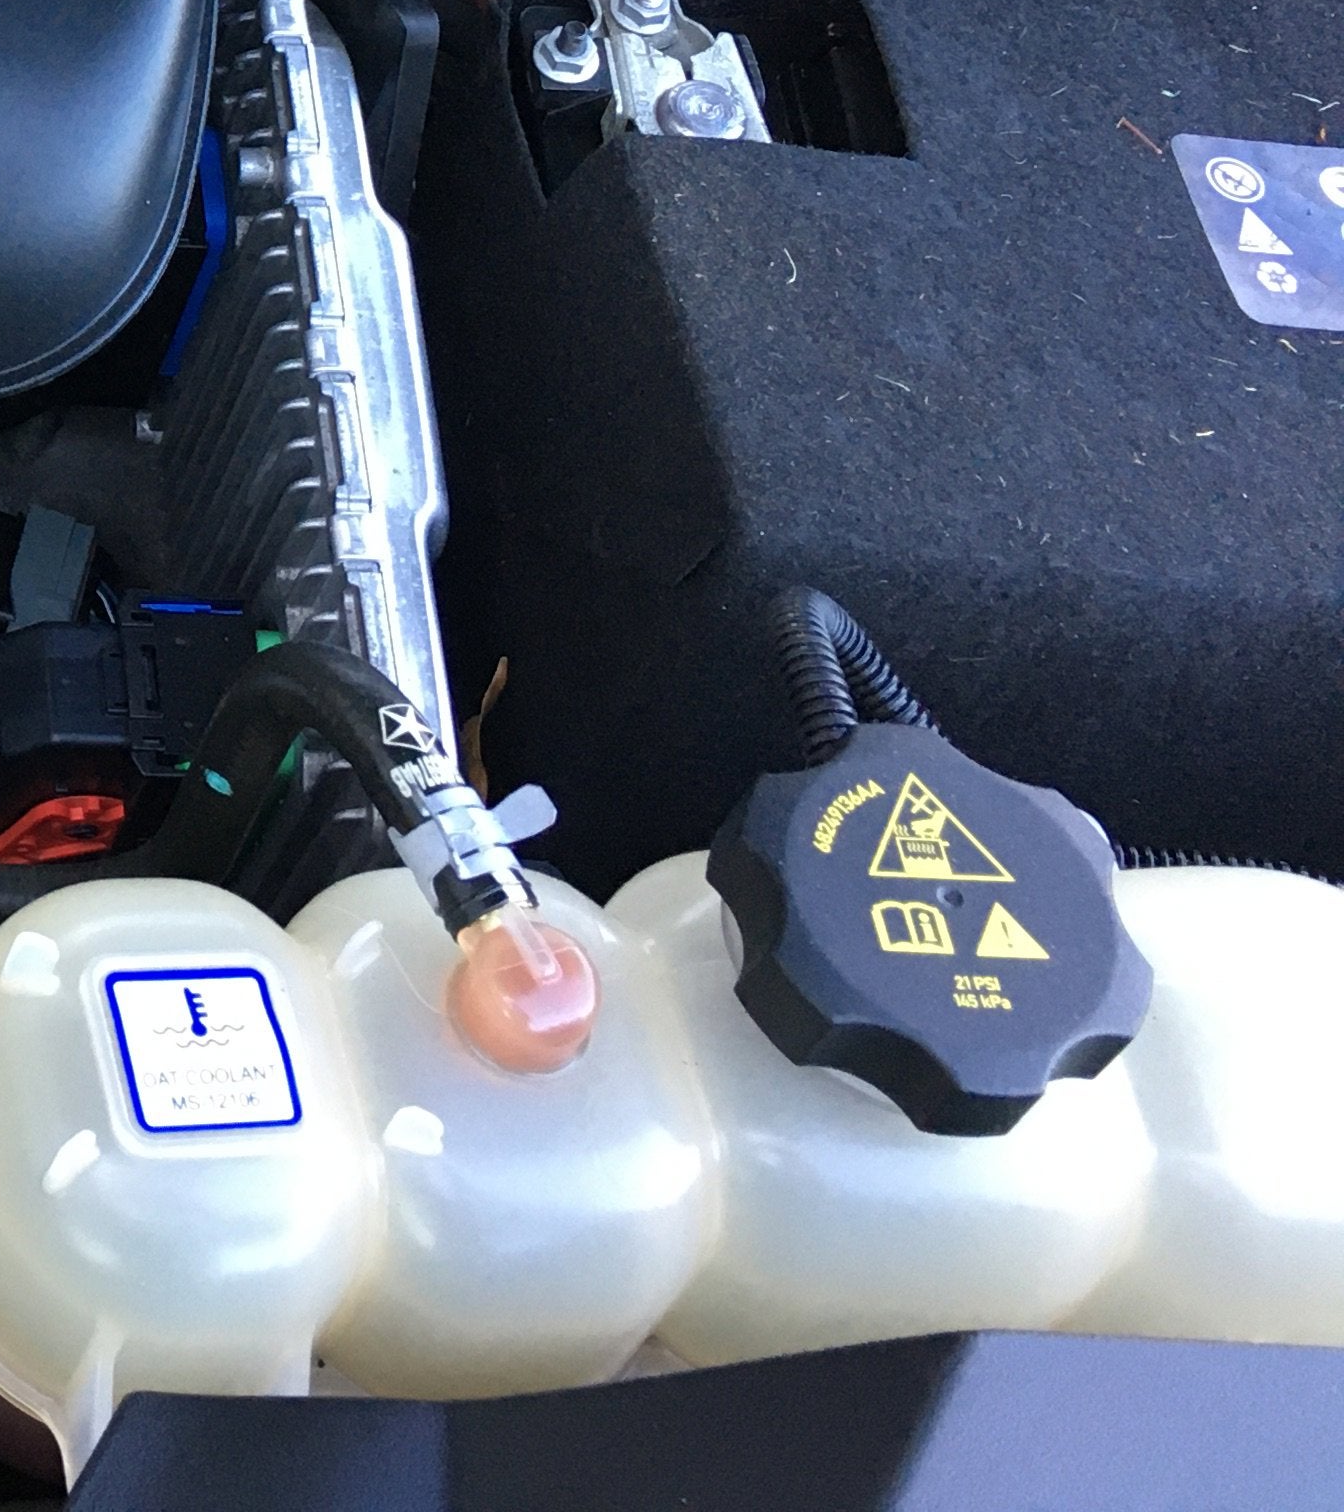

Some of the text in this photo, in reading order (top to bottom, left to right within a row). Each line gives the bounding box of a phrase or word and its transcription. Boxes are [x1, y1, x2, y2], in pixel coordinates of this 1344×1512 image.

[813, 779, 886, 854] 68249136AA
[954, 974, 1001, 991] 21 PSI
[953, 993, 1012, 1010] 145 kPa
[143, 1070, 177, 1088] OAT
